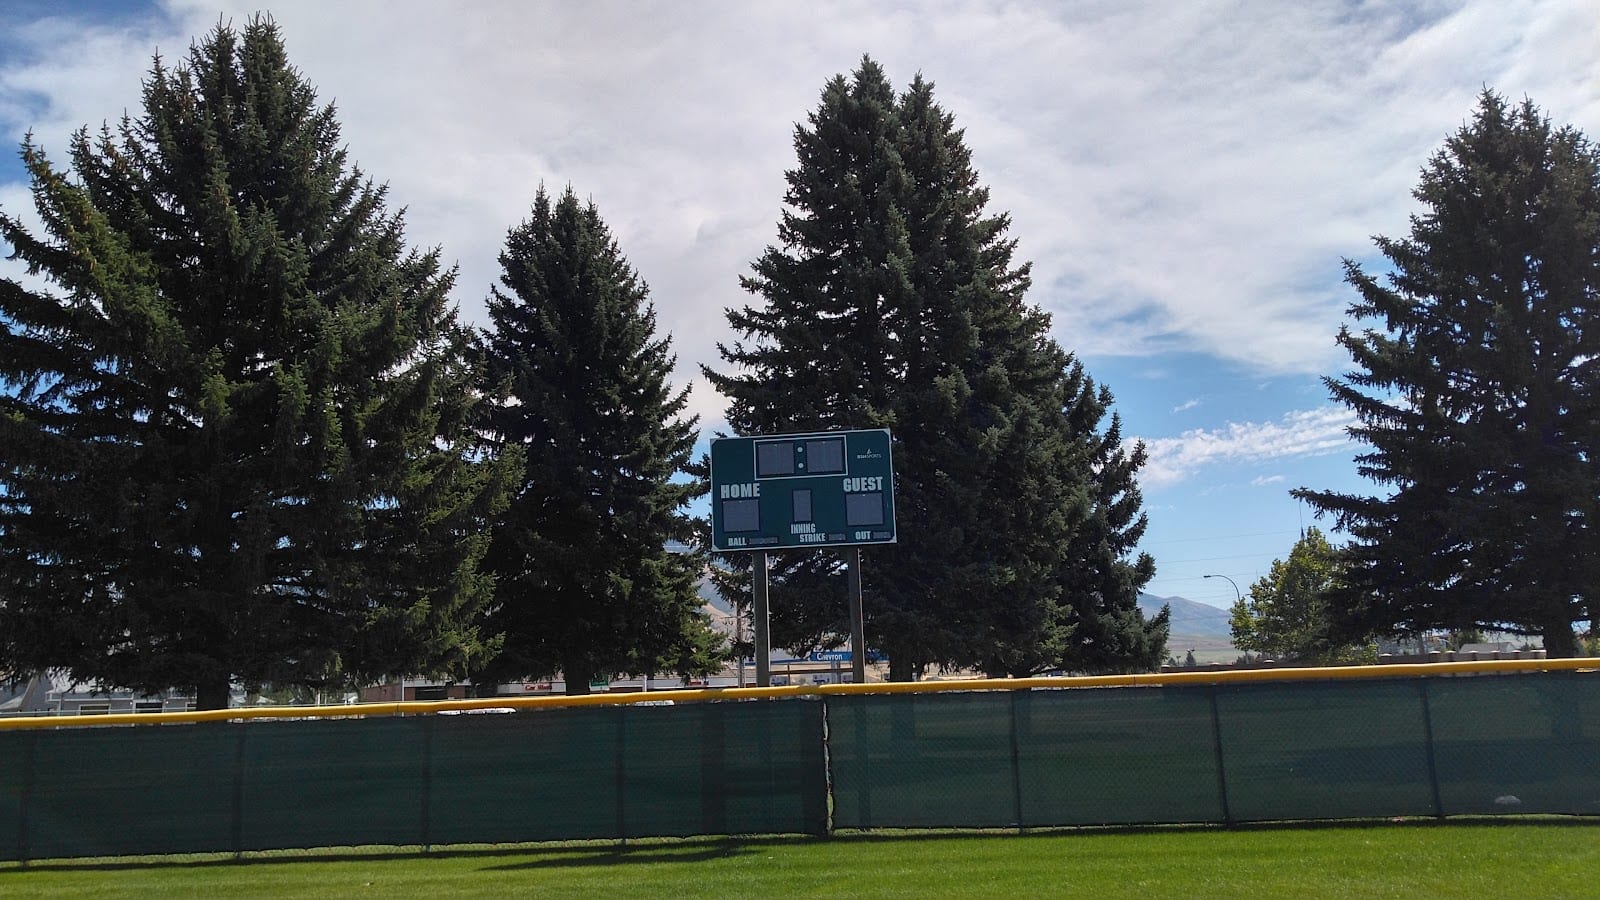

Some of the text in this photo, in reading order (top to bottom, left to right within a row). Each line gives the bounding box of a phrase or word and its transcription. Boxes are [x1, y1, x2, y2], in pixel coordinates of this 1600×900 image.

[843, 476, 883, 492] GUEST
[720, 483, 760, 498] HOME
[790, 523, 816, 535] INNING
[799, 532, 826, 543] STRIKE
[855, 531, 871, 540] OUT
[727, 537, 747, 547] BALL
